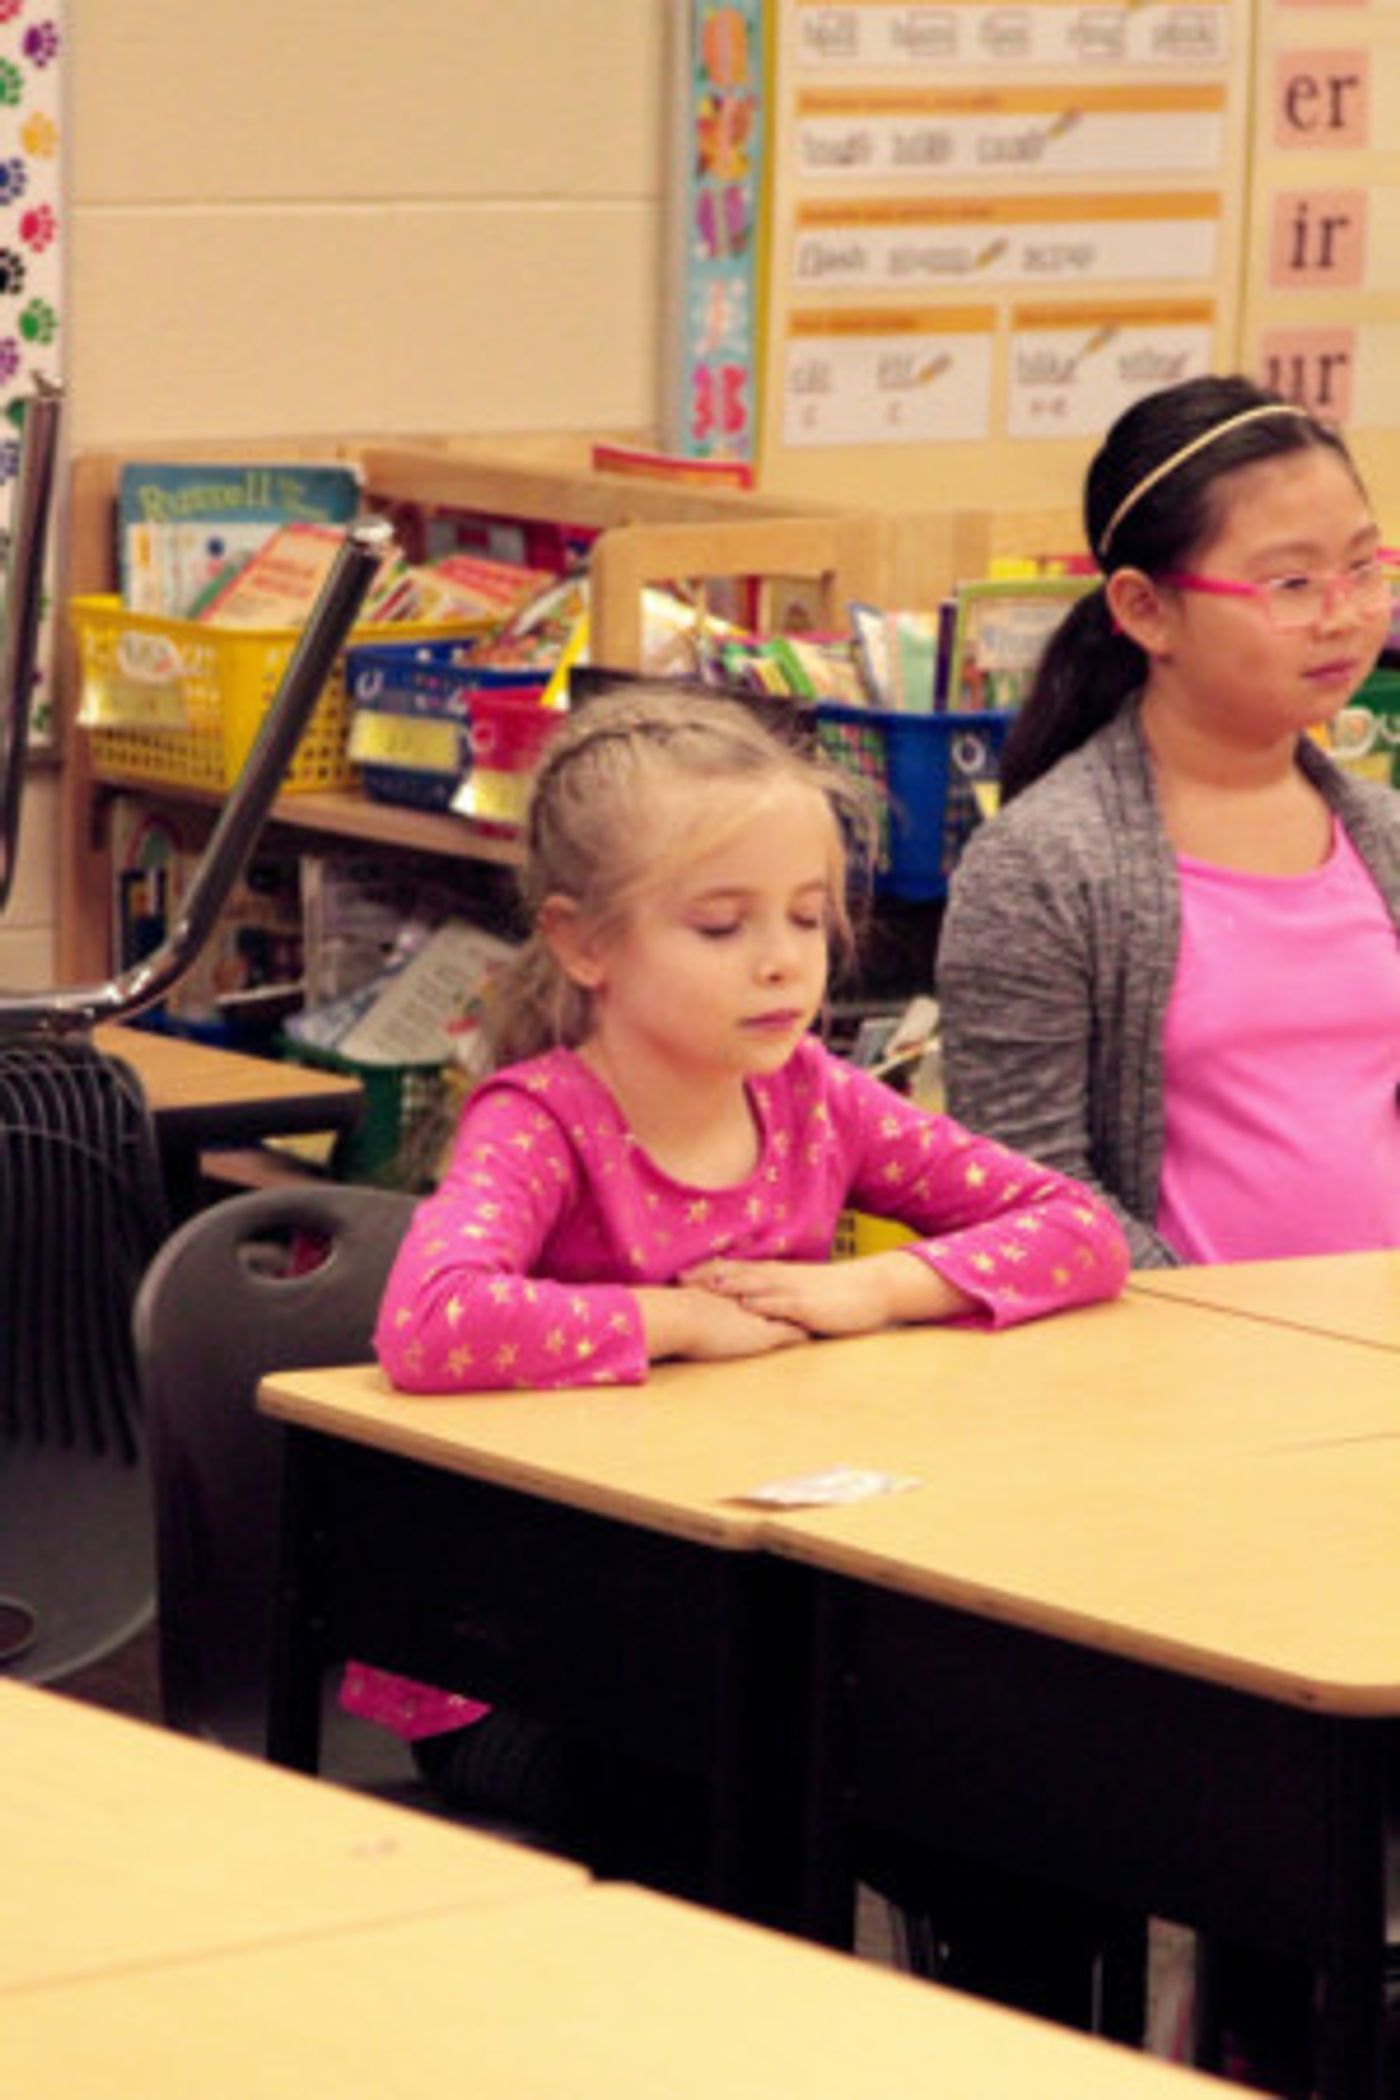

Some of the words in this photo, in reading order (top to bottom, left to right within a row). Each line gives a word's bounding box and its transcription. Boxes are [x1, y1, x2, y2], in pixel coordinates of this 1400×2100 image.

[1283, 73, 1359, 131] er
[1288, 203, 1350, 271] ir
[1266, 352, 1348, 406] ur
